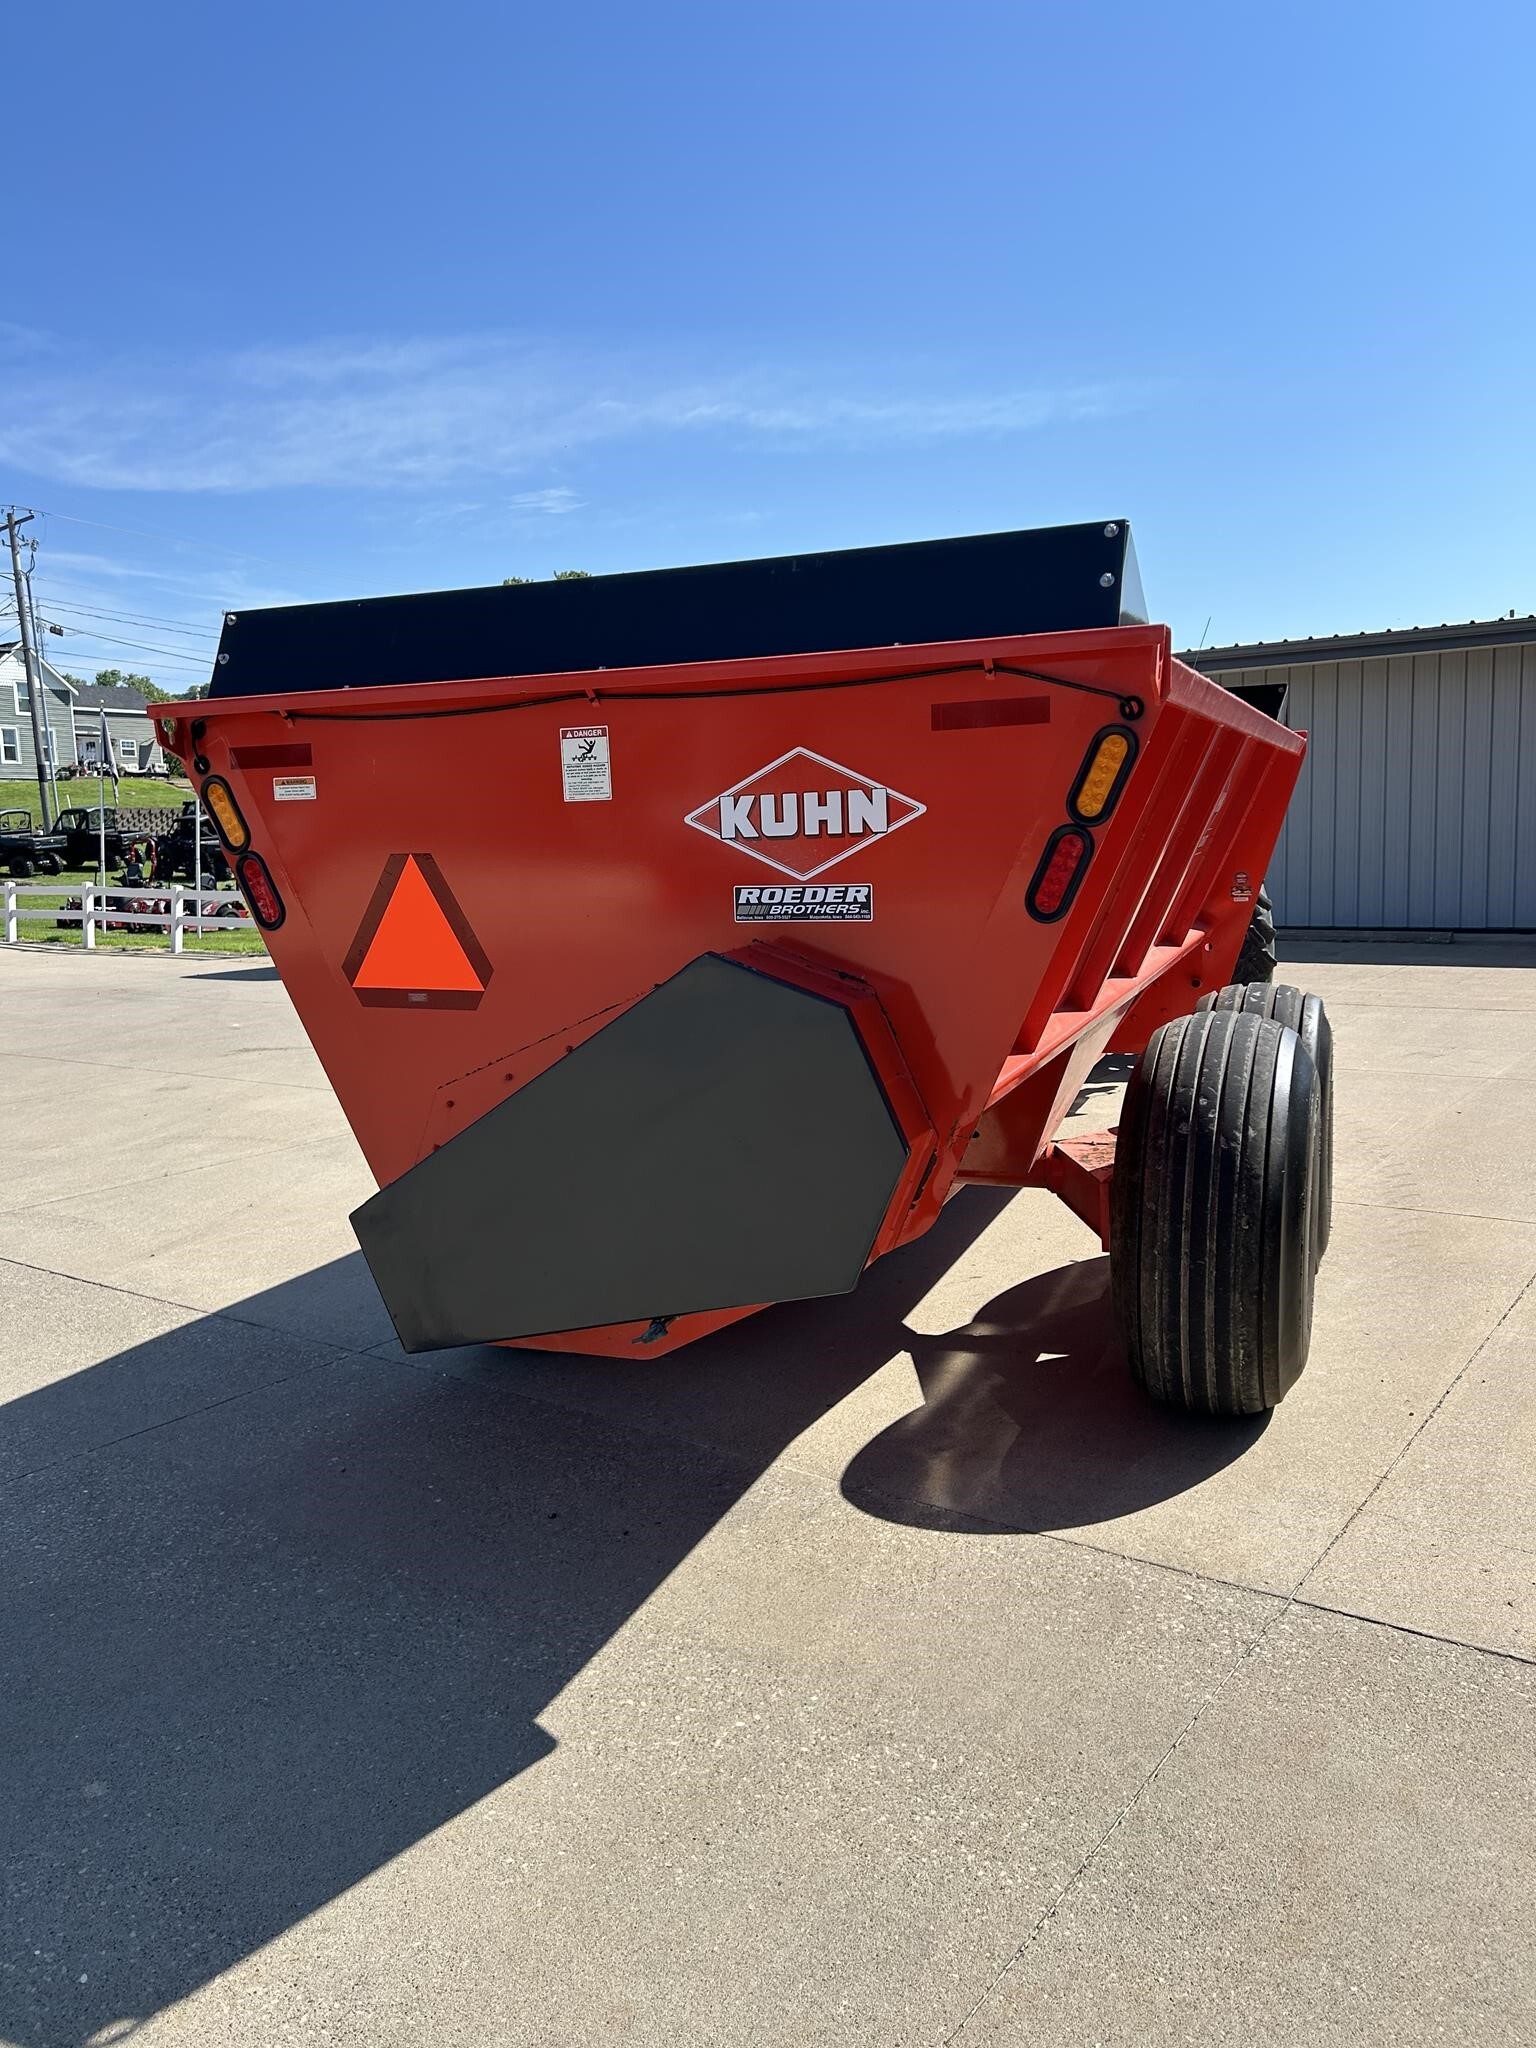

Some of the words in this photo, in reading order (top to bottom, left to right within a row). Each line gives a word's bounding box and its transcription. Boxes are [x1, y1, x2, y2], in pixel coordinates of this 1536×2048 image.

[719, 788, 888, 838] KUHN
[738, 887, 869, 903] ROEDER
[769, 904, 861, 914] BROTHERS
